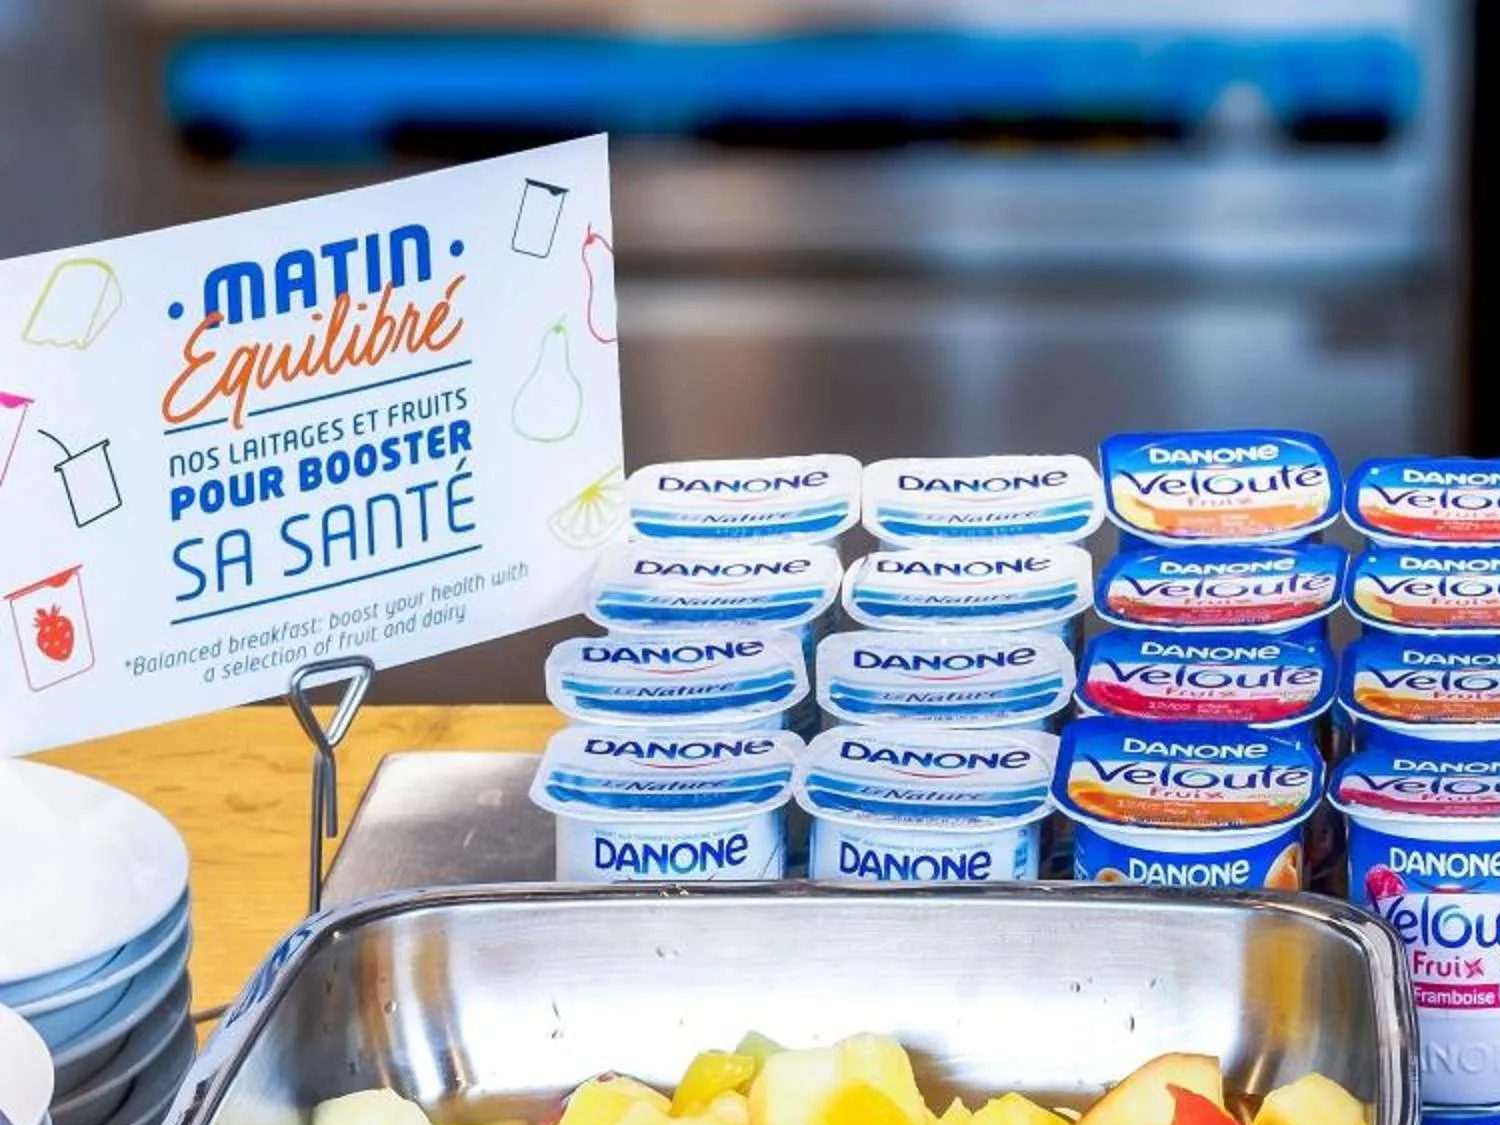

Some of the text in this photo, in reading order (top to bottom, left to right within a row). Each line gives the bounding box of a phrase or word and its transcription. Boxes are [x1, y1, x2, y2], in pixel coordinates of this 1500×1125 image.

[203, 222, 432, 329] MATIN
[169, 387, 468, 477] NOS LAITAGES ET FRUITS
[1150, 444, 1279, 464] DANONE
[170, 419, 473, 521] POUR BOOSTER
[658, 471, 829, 493] DANONE
[899, 471, 1068, 493] DANONE
[1116, 463, 1323, 495] Velouté
[174, 458, 477, 603] SA SANTÉ
[633, 559, 811, 577] DANONE
[877, 557, 1051, 576] DANONE
[1159, 558, 1295, 574] DANONE
[1122, 572, 1331, 598] Velouté
[228, 620, 321, 656] breakfast:
[329, 605, 378, 629] boost
[385, 591, 425, 619] your
[430, 573, 485, 602] health
[490, 561, 529, 586] with
[204, 605, 466, 683] a selection of fruit and dairy
[582, 641, 764, 664] DANONE
[1140, 641, 1280, 660] DANONE
[853, 647, 1036, 671] DANONE
[1104, 658, 1319, 688] Velouté
[637, 682, 736, 698] Nature
[905, 690, 1003, 703] Nature
[583, 739, 774, 760] DANONE
[840, 741, 1030, 769] DANONE
[1122, 738, 1268, 758] DANONE
[1085, 754, 1308, 790] Velouté
[624, 778, 731, 792] Nature
[883, 788, 984, 801] Nature
[594, 833, 748, 874] DANONE
[840, 841, 991, 881] DANONE
[1129, 858, 1249, 886] DANONE
